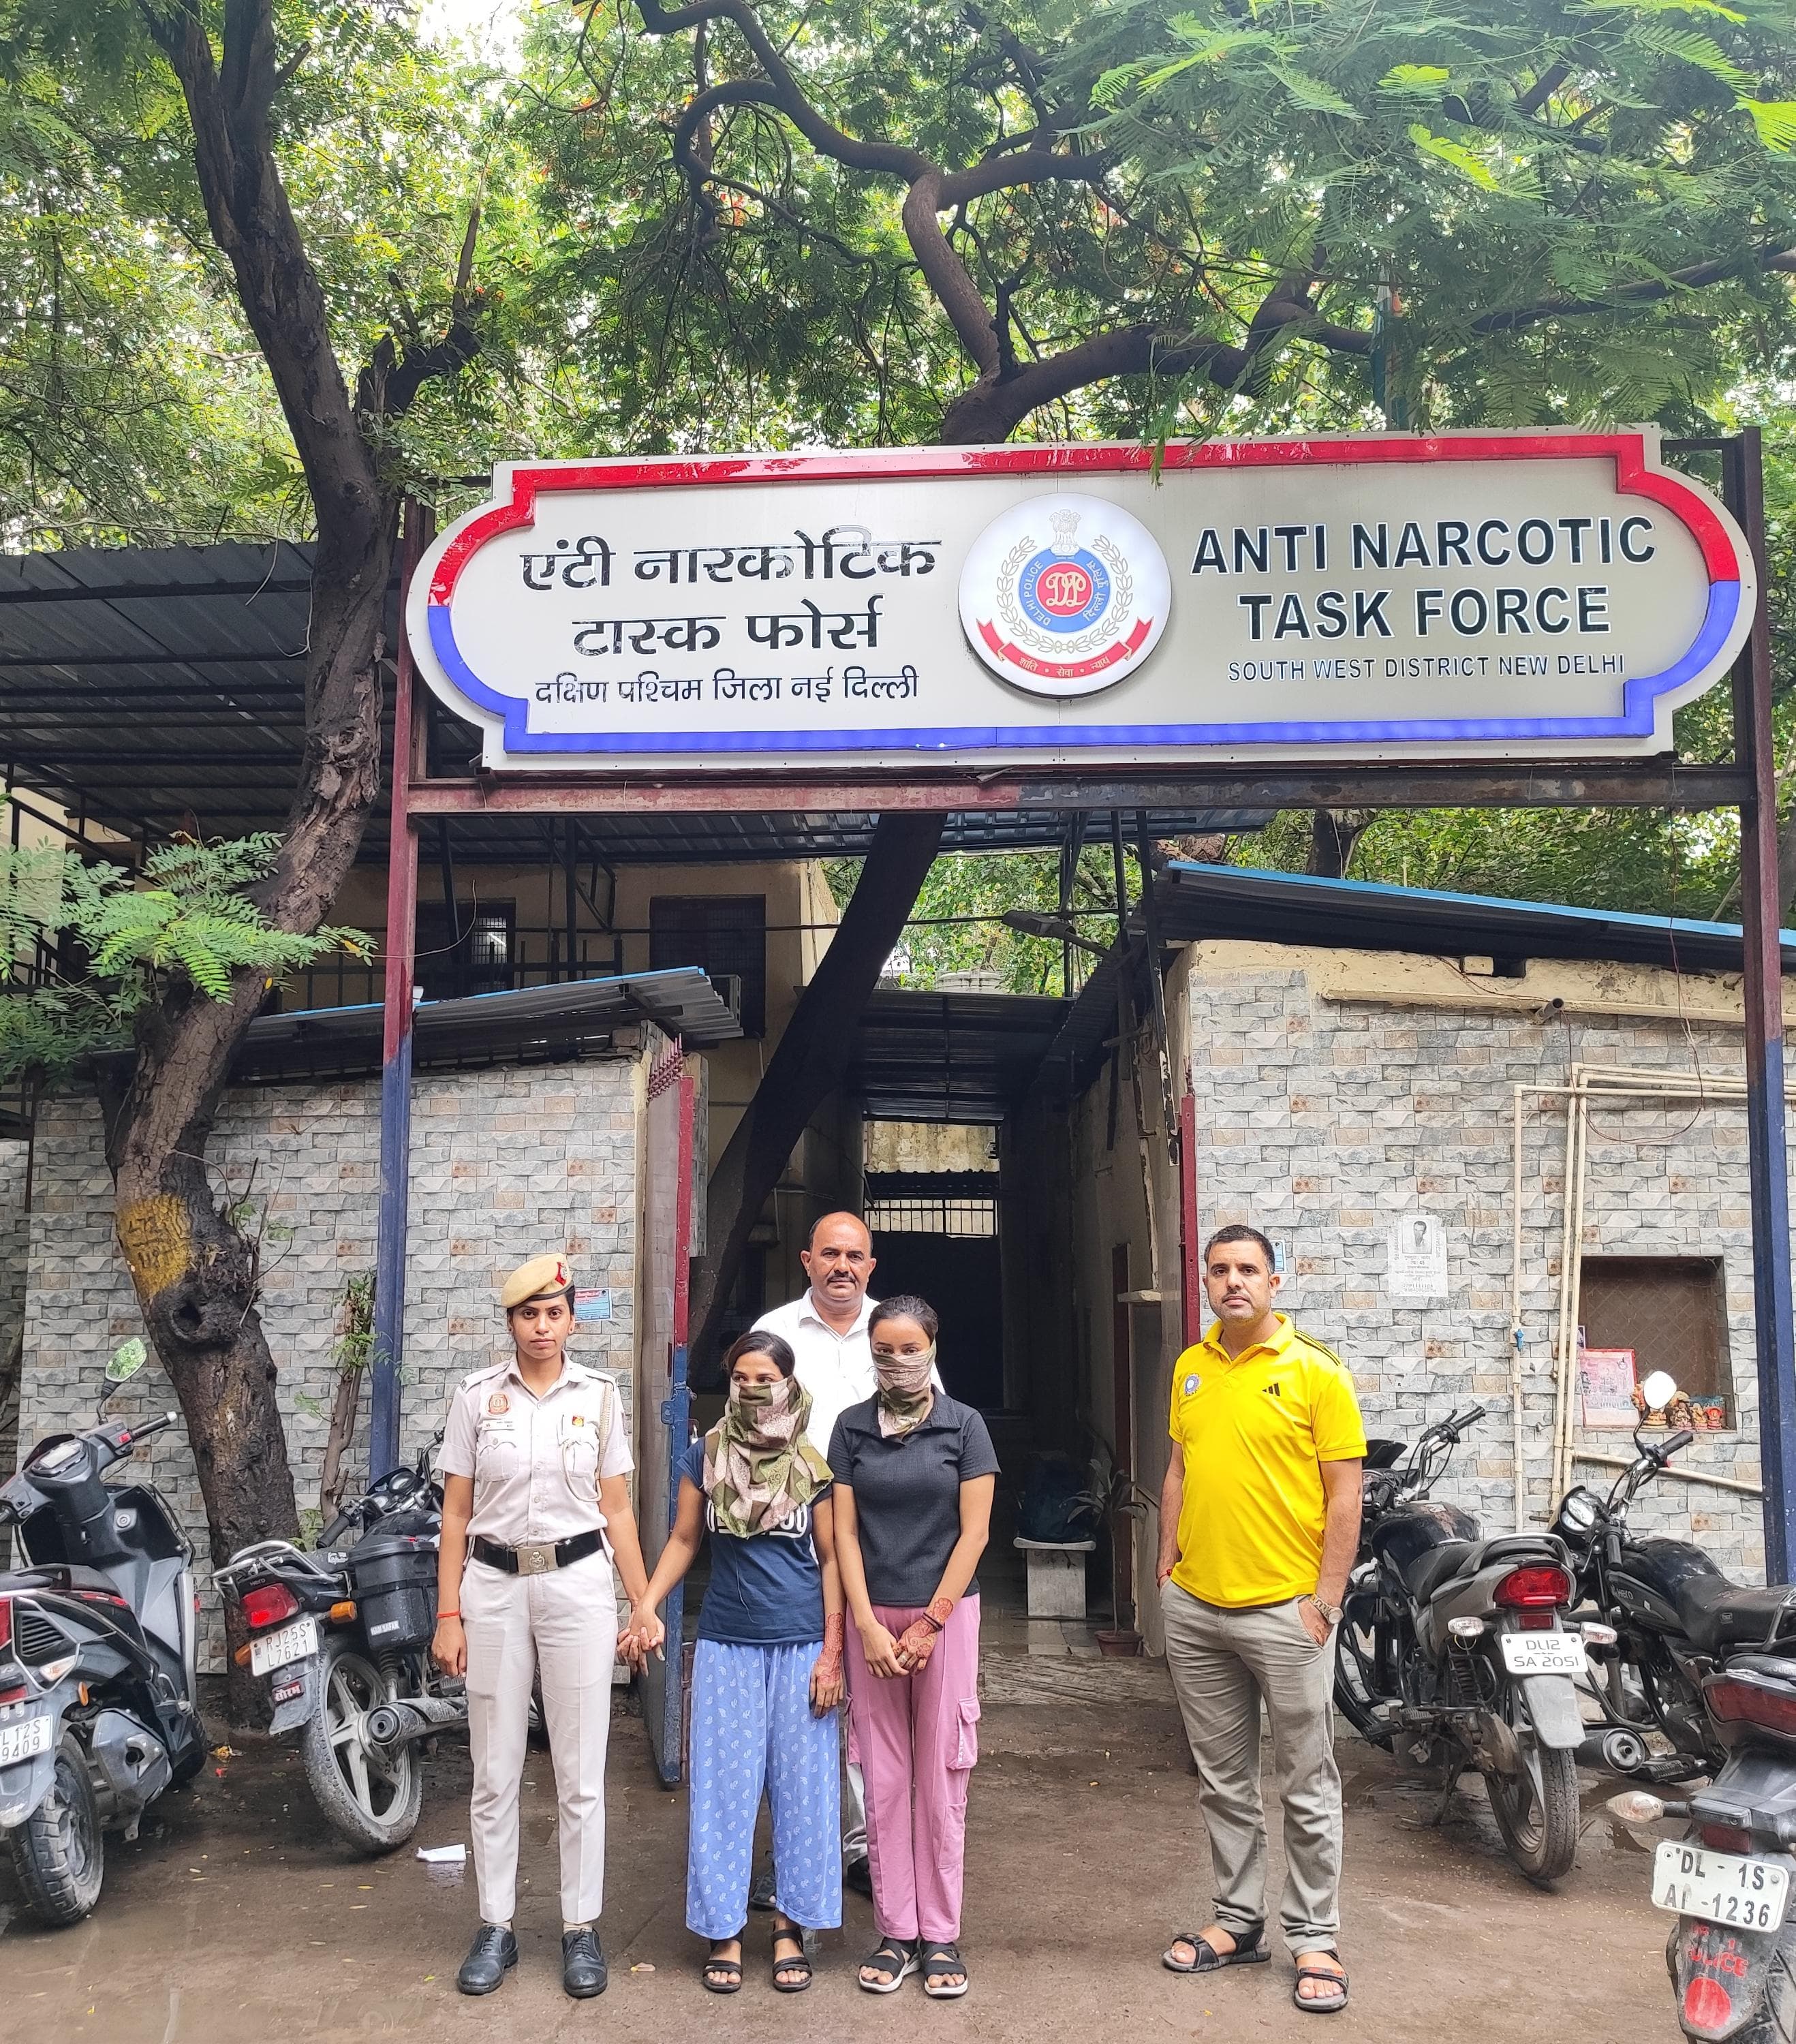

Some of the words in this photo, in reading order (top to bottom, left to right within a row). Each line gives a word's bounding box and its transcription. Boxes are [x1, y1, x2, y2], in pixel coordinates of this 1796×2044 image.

[519, 536, 615, 591] एंटी
[634, 525, 942, 587] नारकोटिक
[1190, 523, 1328, 576] ANTI
[1351, 515, 1656, 570] NARCOTIC
[1024, 560, 1043, 598] POLICE
[572, 616, 727, 657] टास्क
[746, 595, 885, 652] फोर्स
[1024, 599, 1051, 626] DELHI
[1238, 587, 1394, 642] TASK
[1414, 585, 1612, 638] FORCE
[535, 672, 608, 704] दक्षिण
[618, 670, 702, 703] पश्चिम
[713, 668, 781, 701] जिला
[791, 666, 834, 702] नई
[843, 665, 919, 699] दिल्ली
[1056, 666, 1074, 677] सेवा
[1228, 659, 1305, 681] SOUTH
[1313, 658, 1375, 680] WEST
[1384, 656, 1489, 679] DISTRICT
[1498, 655, 1548, 677] NEW
[1557, 653, 1626, 675] DELHI
[266, 1623, 307, 1651] RJ25S
[267, 1639, 309, 1668] L7621
[1514, 1656, 1537, 1667] SA
[1542, 1656, 1579, 1667] 2051
[1680, 1849, 1706, 1878] DL
[1738, 1863, 1765, 1891] 1S
